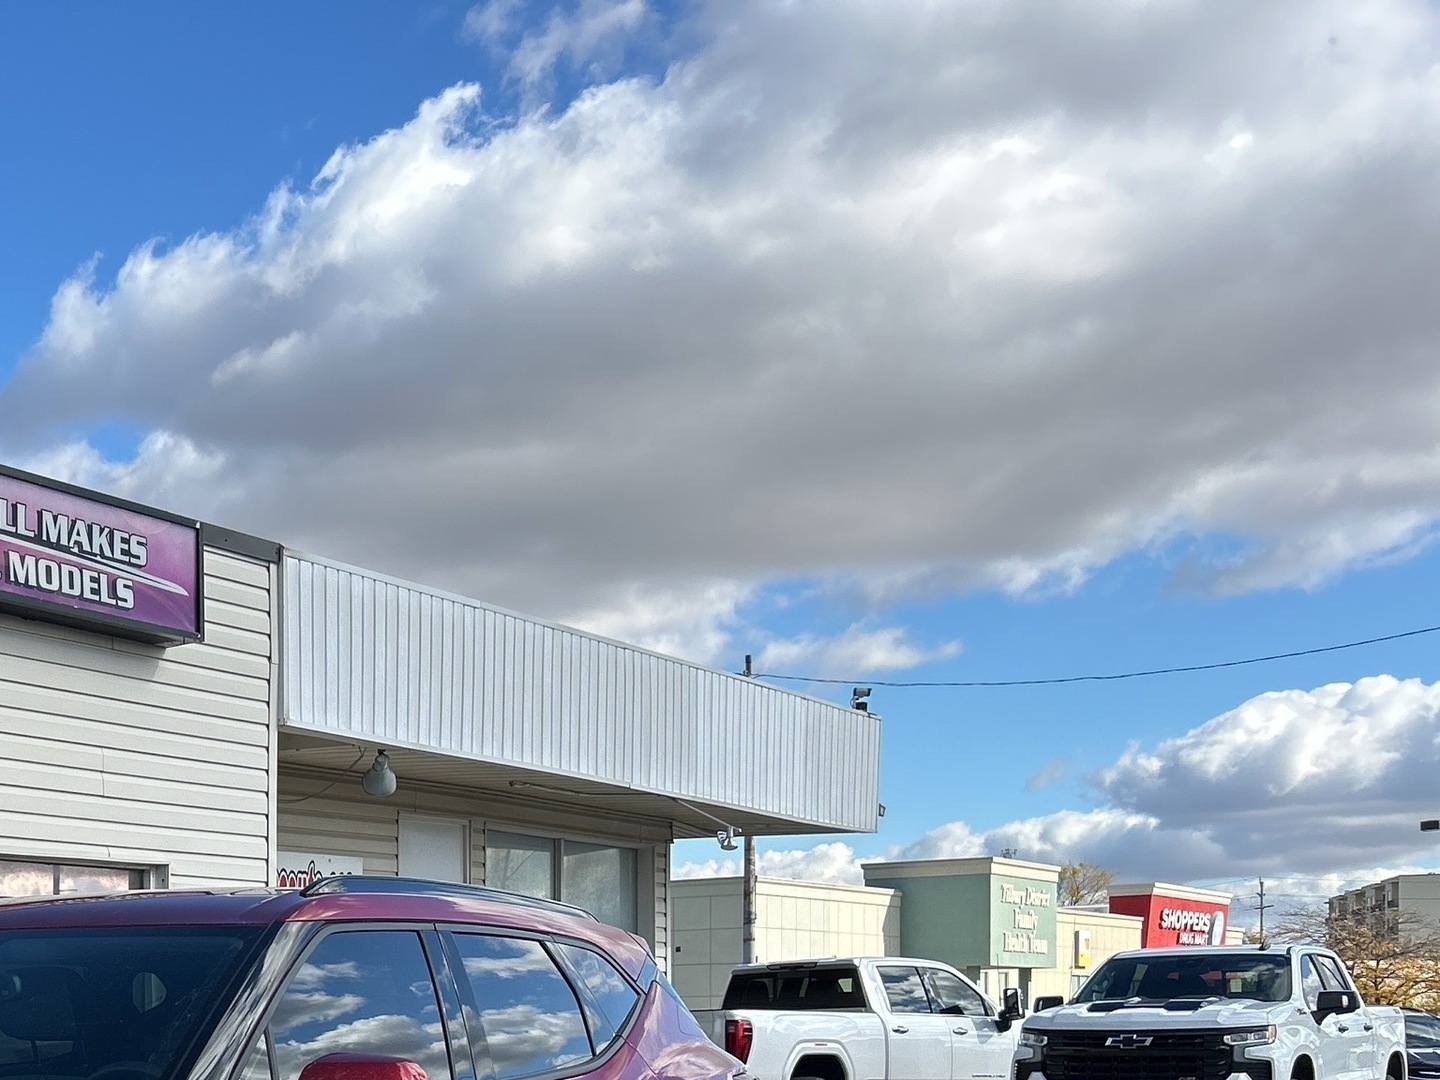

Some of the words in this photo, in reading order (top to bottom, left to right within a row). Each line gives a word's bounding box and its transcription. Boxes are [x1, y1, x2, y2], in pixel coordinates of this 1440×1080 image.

[38, 509, 148, 566] MAKES
[8, 557, 136, 610] MODELS
[1161, 908, 1211, 933] SHOPPERS
[1179, 932, 1194, 944] DRUG
[1194, 934, 1209, 946] MART
